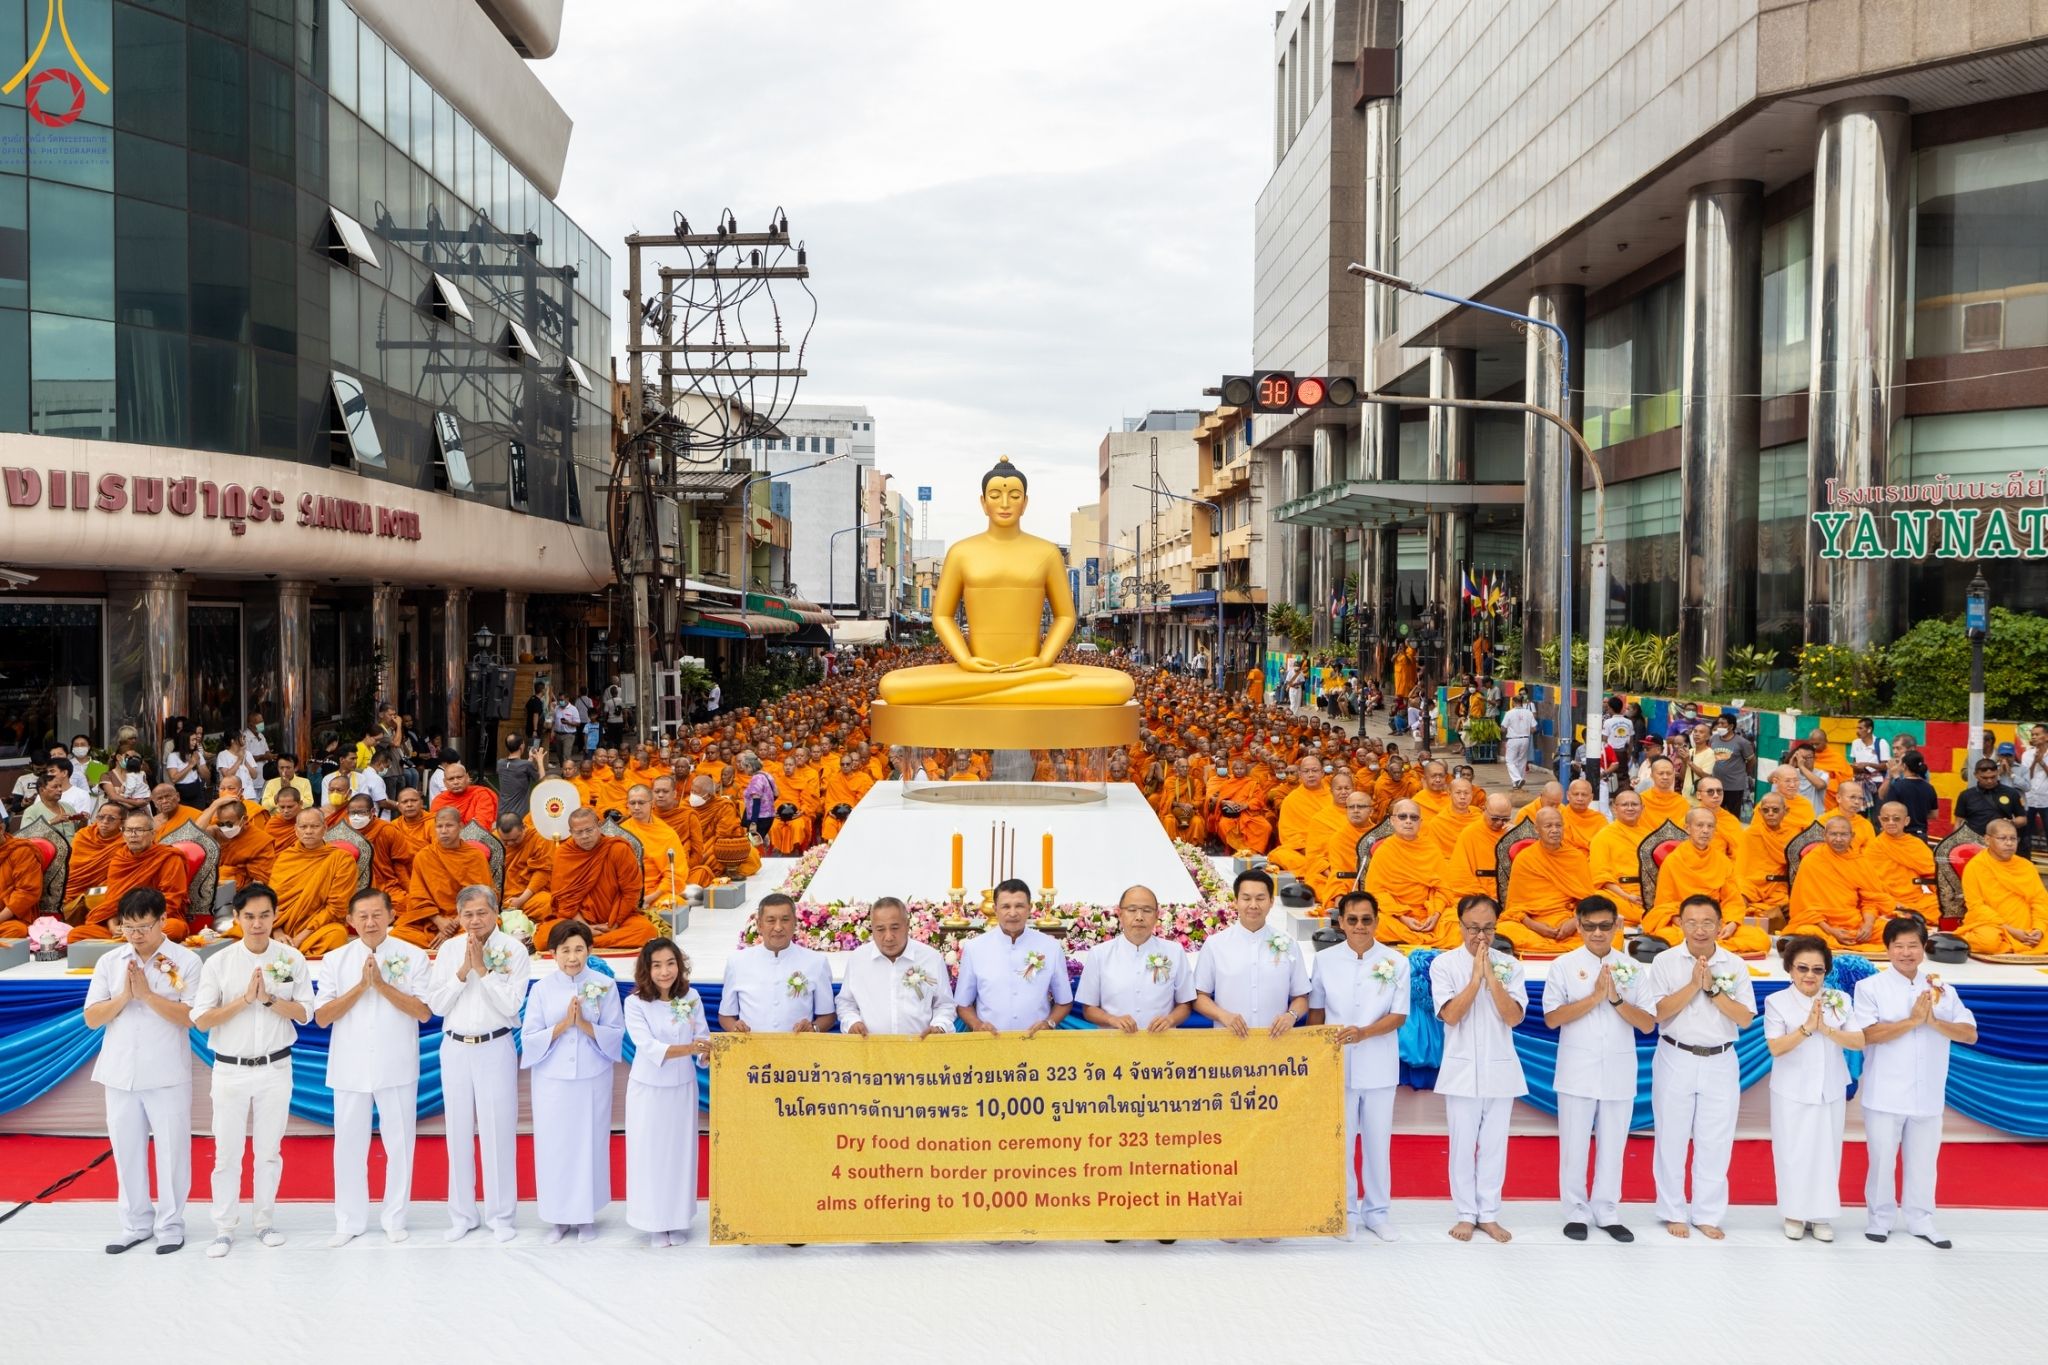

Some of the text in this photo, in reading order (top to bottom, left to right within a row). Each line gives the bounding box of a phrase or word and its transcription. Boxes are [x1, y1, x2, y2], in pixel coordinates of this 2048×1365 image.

[1262, 380, 1288, 405] 38
[297, 492, 422, 541] SAKURA HOTEL
[1812, 508, 2048, 559] YANNAT
[1046, 1066, 1077, 1082] 323
[1083, 1062, 1106, 1081] วัด
[1112, 1065, 1123, 1081] 4
[1129, 1055, 1308, 1080] จังหวัดชายแดนภาคใต้
[774, 1096, 969, 1119] ในโครงการตักบาตรพระ
[975, 1096, 1045, 1121] 10,000
[1051, 1092, 1223, 1122] รูปหาดใหญ่นานาชาติ
[836, 1130, 1222, 1153] Dry food donation ceremony for 323 temples
[831, 1159, 1238, 1183] 4 southern border provinces from International
[816, 1190, 1242, 1213] alms offering to 10,000 Monks Project in HatYai
